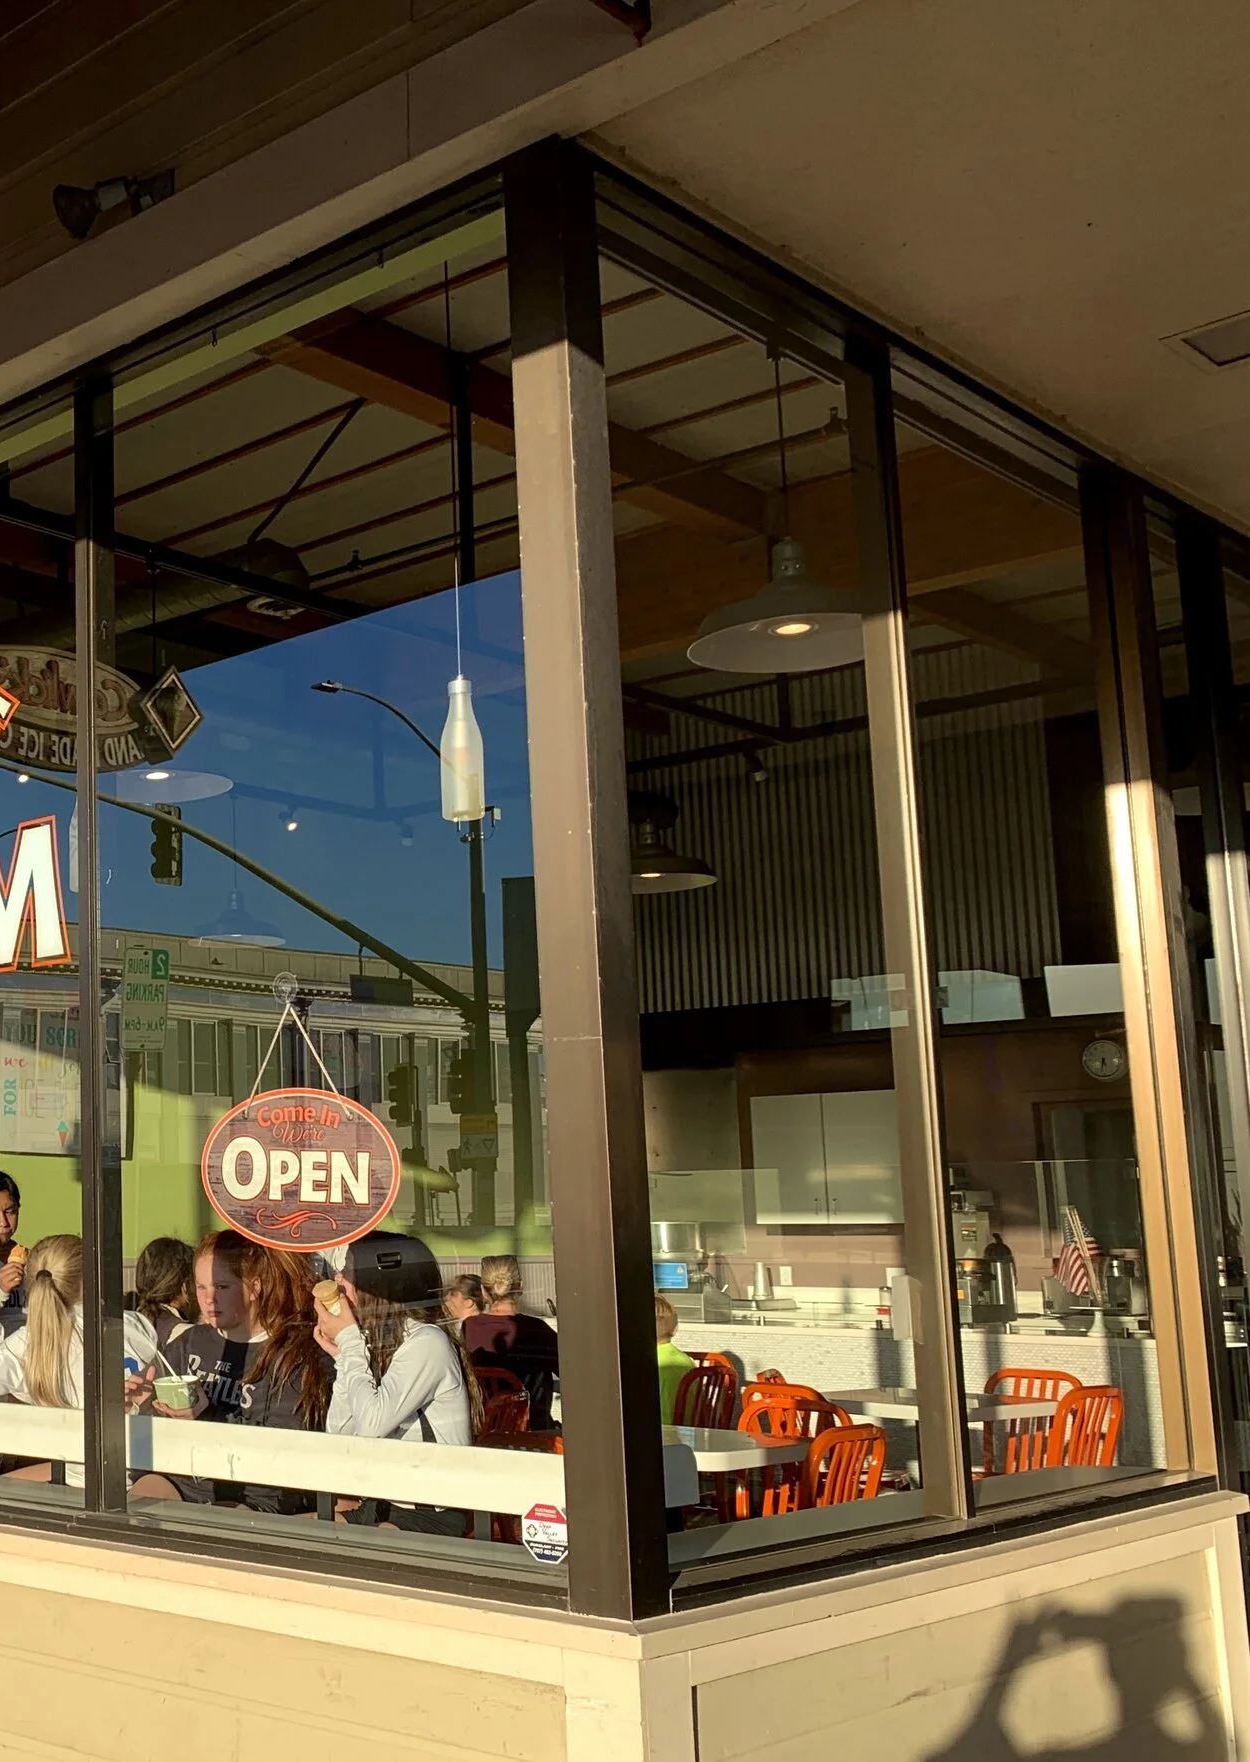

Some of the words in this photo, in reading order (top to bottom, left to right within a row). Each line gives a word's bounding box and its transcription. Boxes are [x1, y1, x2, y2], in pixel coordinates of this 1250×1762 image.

[4, 1079, 17, 1116] FOR
[257, 1105, 317, 1128] Come
[320, 1104, 341, 1129] In
[220, 1136, 372, 1206] OPEN
[214, 1360, 232, 1373] THE
